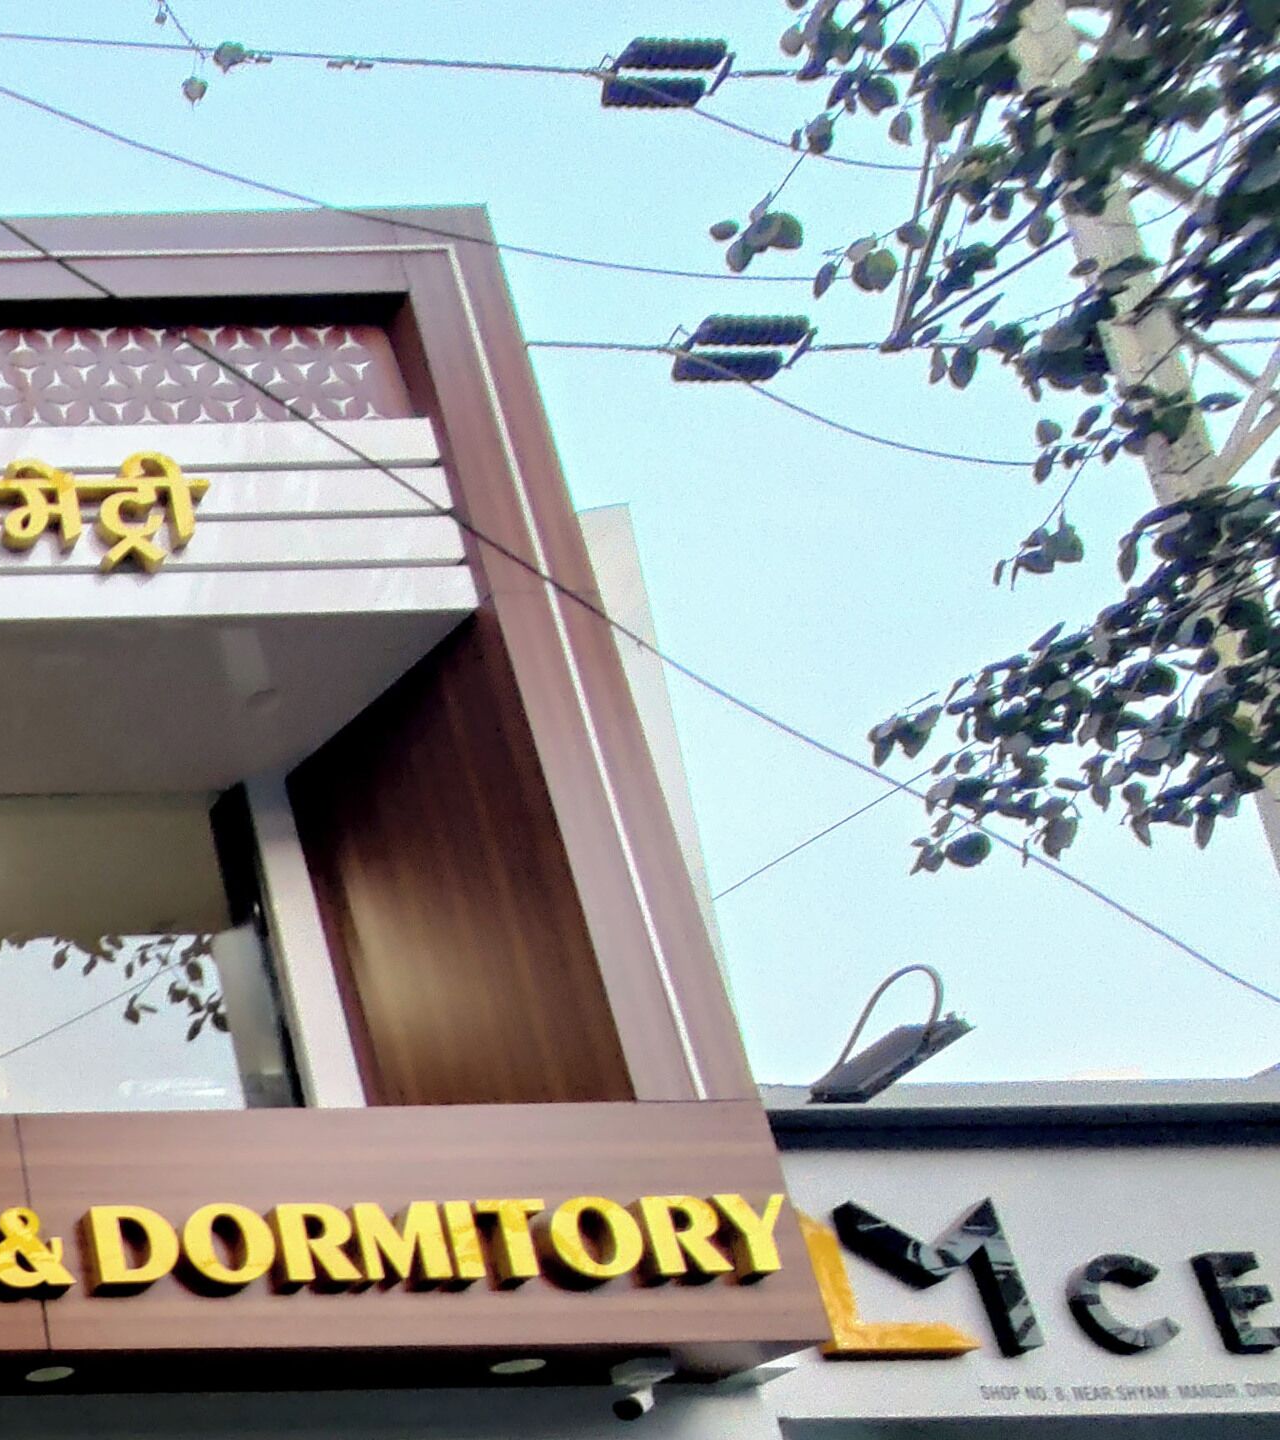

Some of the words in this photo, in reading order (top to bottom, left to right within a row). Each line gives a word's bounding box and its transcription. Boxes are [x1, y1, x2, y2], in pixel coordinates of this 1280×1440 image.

[80, 1193, 786, 1296] DORMITORY
[980, 1385, 1020, 1400] SHOP
[1071, 1386, 1113, 1401] NEAR
